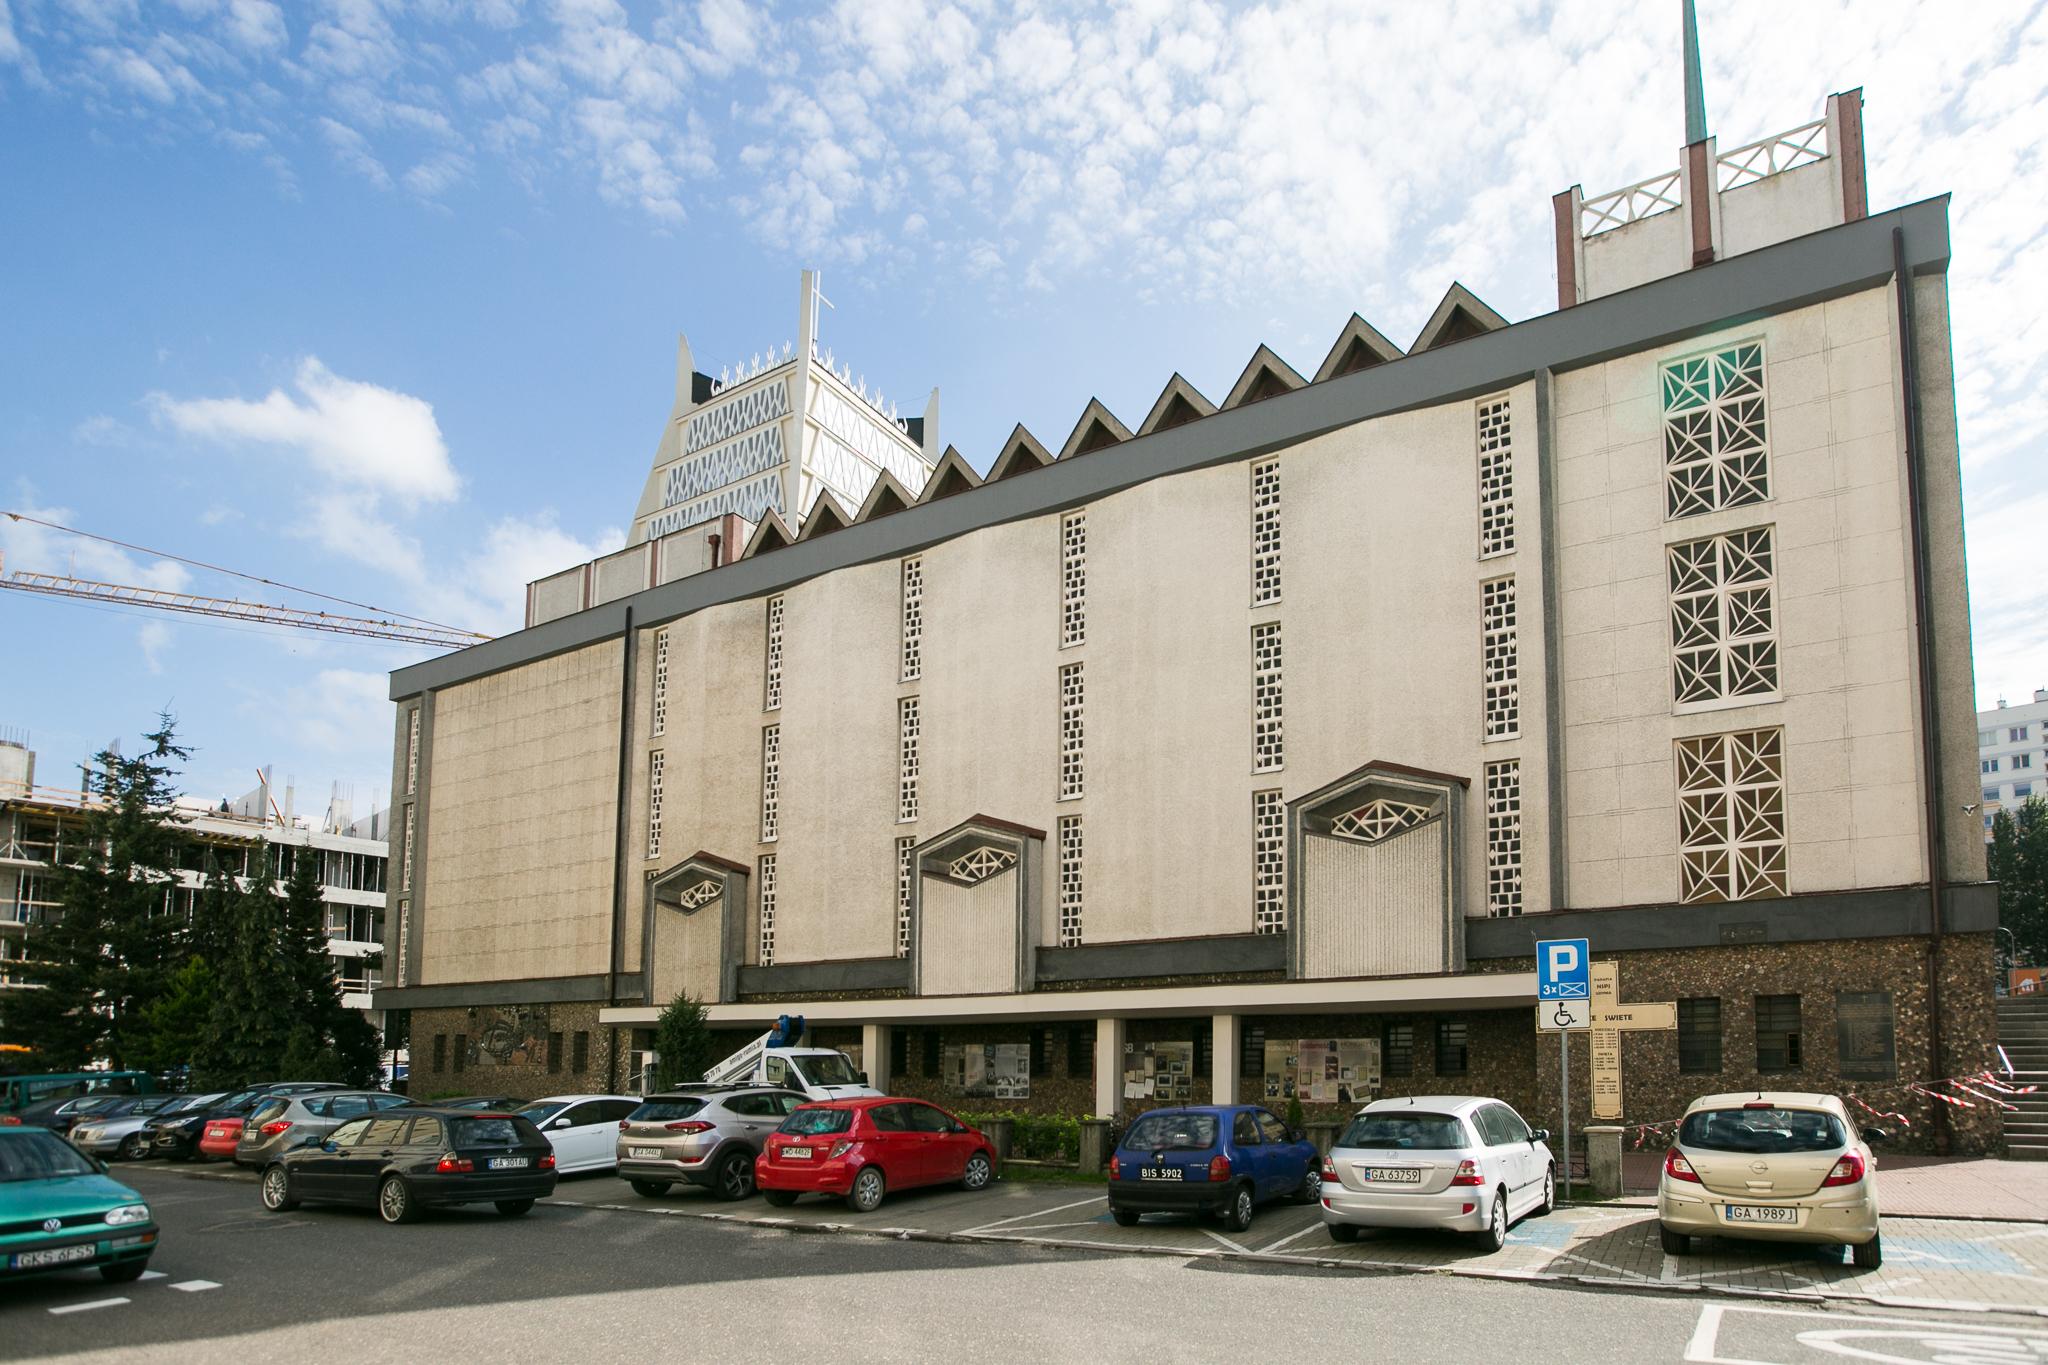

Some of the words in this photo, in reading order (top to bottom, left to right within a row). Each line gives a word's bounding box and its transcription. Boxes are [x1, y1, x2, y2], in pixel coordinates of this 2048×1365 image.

[1549, 945, 1578, 982] P
[1141, 1168, 1158, 1178] BIS
[1161, 1169, 1183, 1179] 5902
[1371, 1169, 1386, 1180] GA
[1388, 1170, 1418, 1181] 63759
[1733, 1207, 1752, 1218] GA
[1757, 1208, 1793, 1221] 1989J
